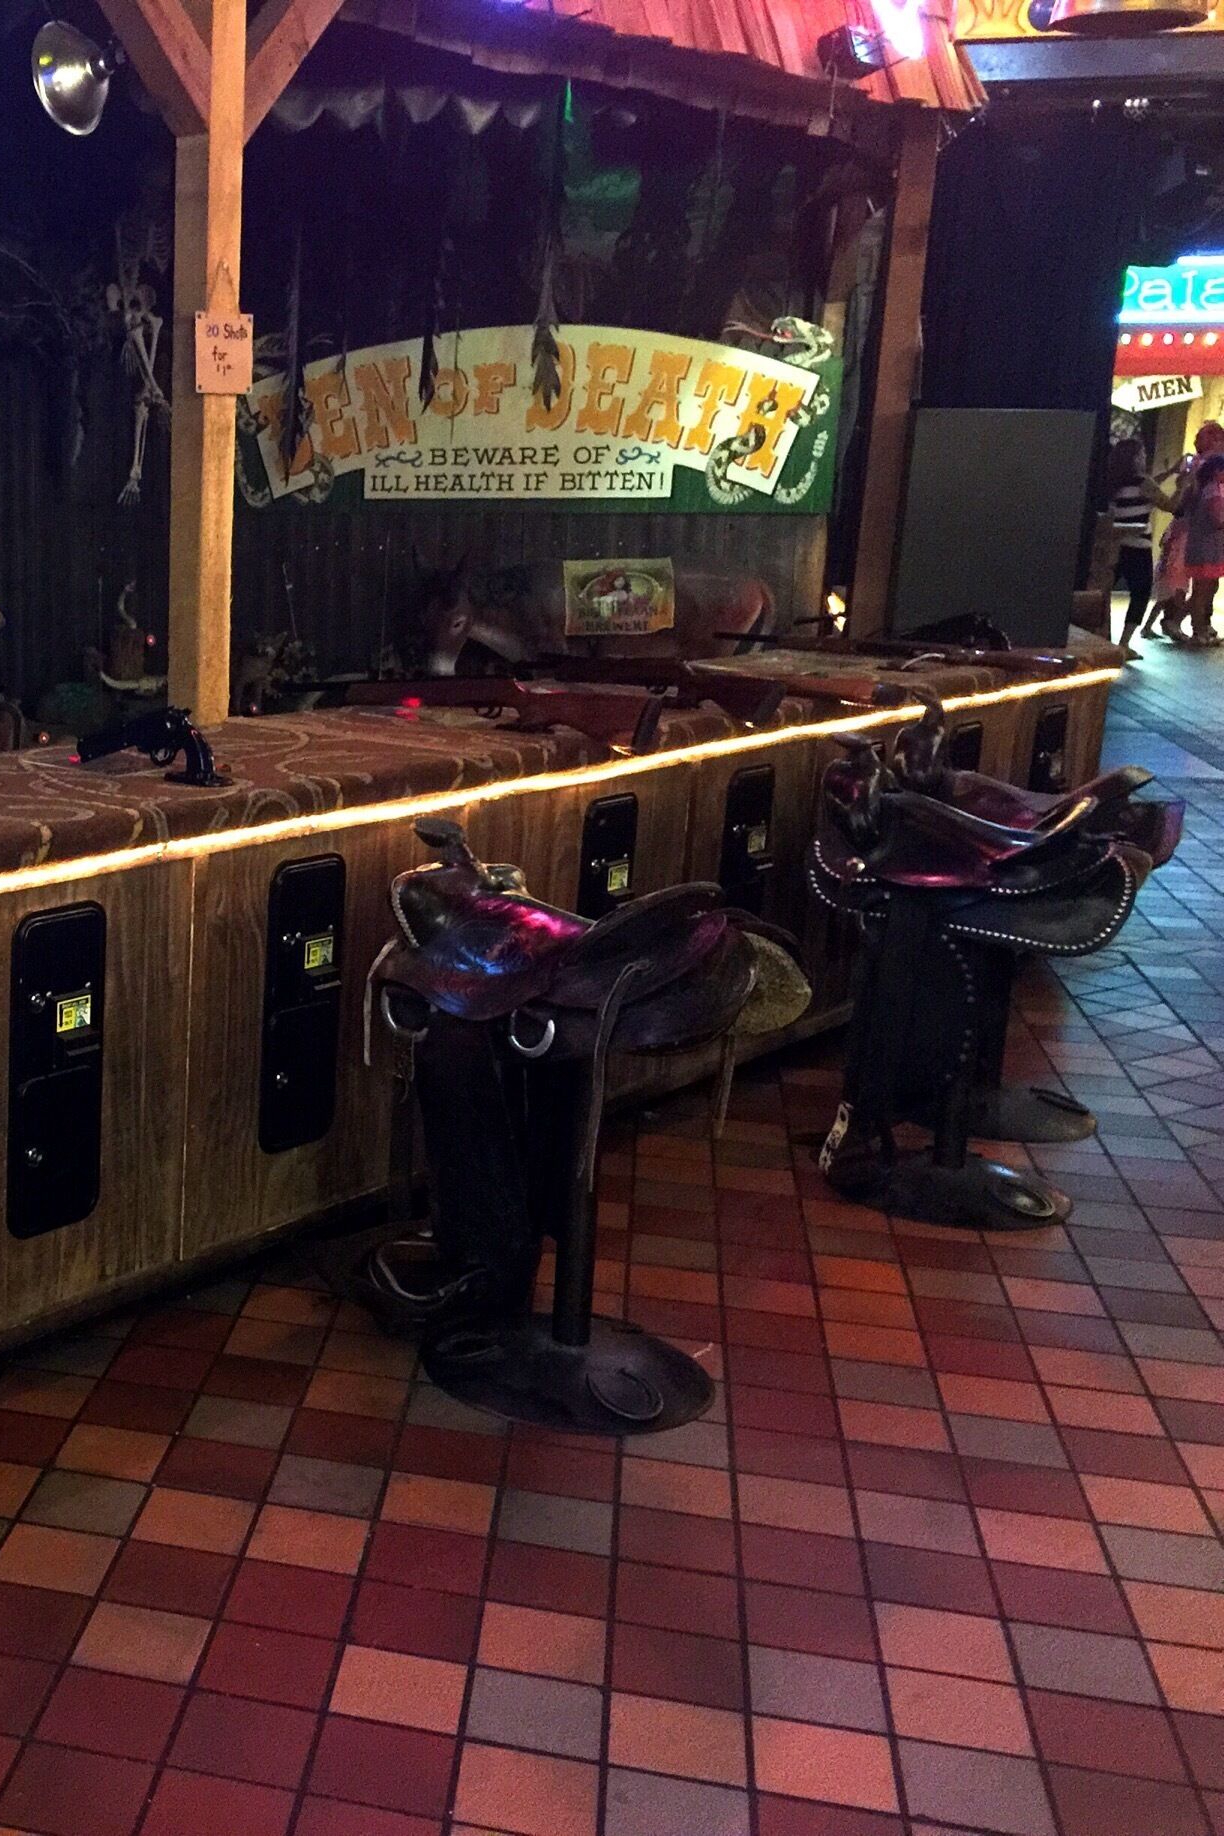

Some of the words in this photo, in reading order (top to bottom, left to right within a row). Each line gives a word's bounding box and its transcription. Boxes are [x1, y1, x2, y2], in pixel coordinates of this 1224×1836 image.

[206, 324, 219, 338] 20
[223, 323, 248, 341] Shots
[212, 345, 227, 361] for
[1137, 375, 1194, 402] MEN
[429, 362, 517, 418] OF
[525, 340, 807, 478] DEATH
[428, 446, 560, 467] BEWARE
[573, 444, 611, 465] OF
[370, 475, 409, 494] ILL
[414, 472, 515, 493] HEALTH
[523, 471, 549, 492] IF
[559, 470, 664, 492] BITTEN!
